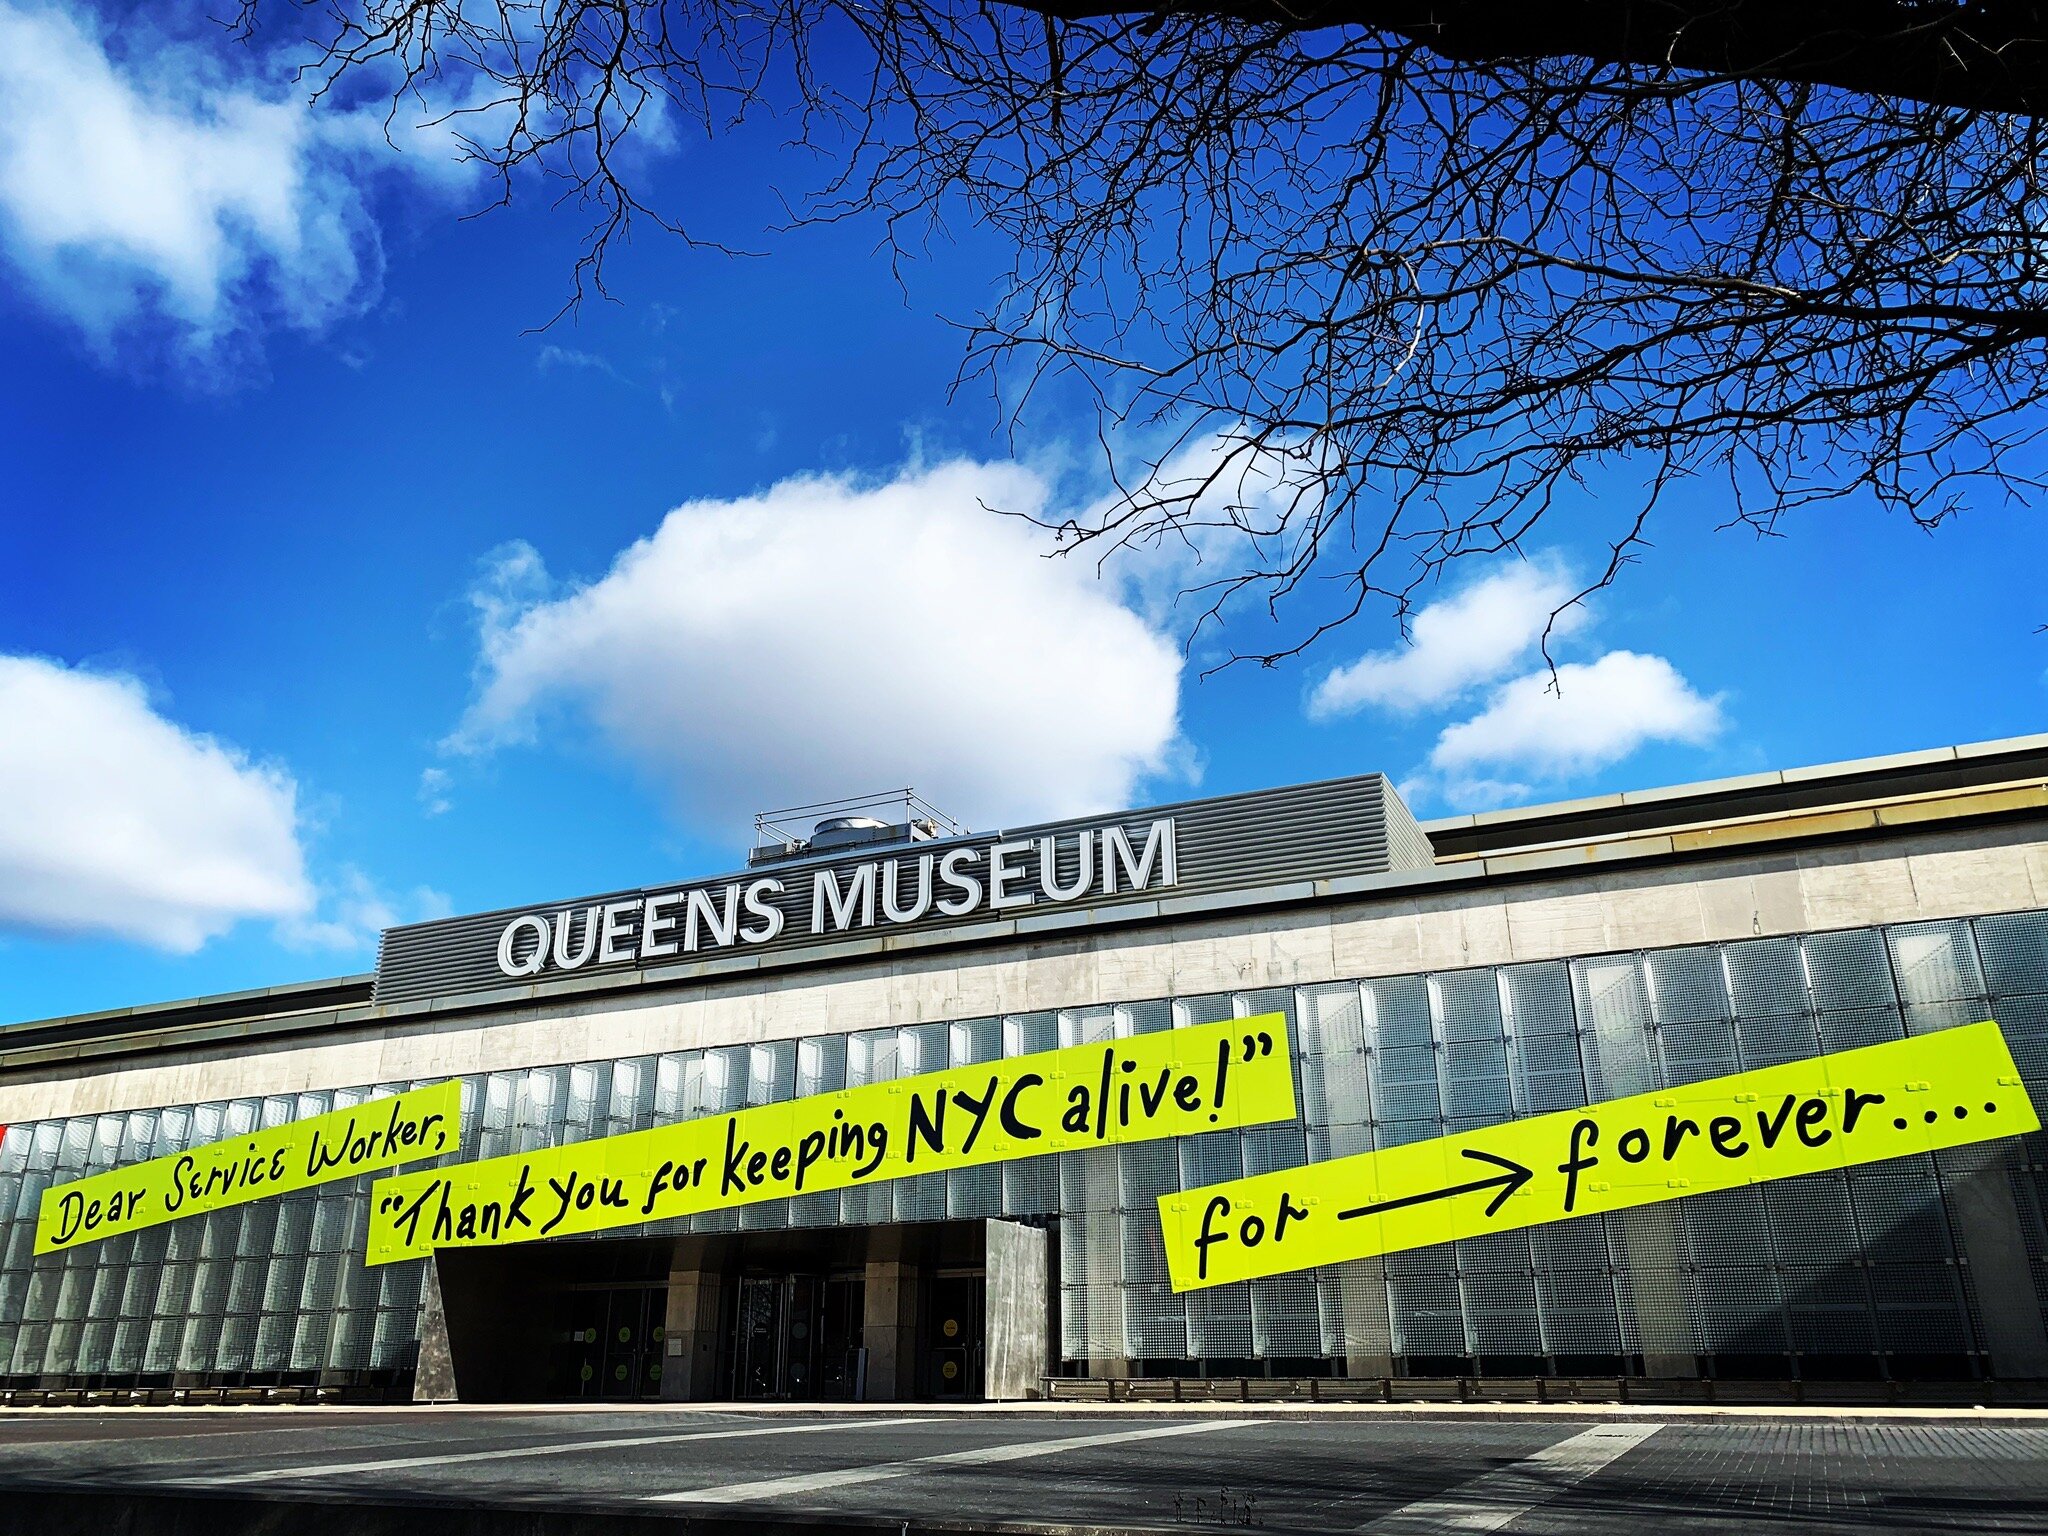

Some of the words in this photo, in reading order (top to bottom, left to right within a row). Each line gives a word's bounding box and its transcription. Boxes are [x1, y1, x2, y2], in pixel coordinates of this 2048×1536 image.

[496, 878, 785, 977] QUEENS
[811, 816, 1179, 934] MUSEUM
[49, 1189, 148, 1245] Dear
[163, 1142, 287, 1213] Service
[306, 1099, 447, 1178] Worker,
[641, 1158, 709, 1216] for
[719, 1108, 889, 1198] keeping
[905, 1074, 1045, 1165] NYC
[1193, 1194, 1310, 1281] for
